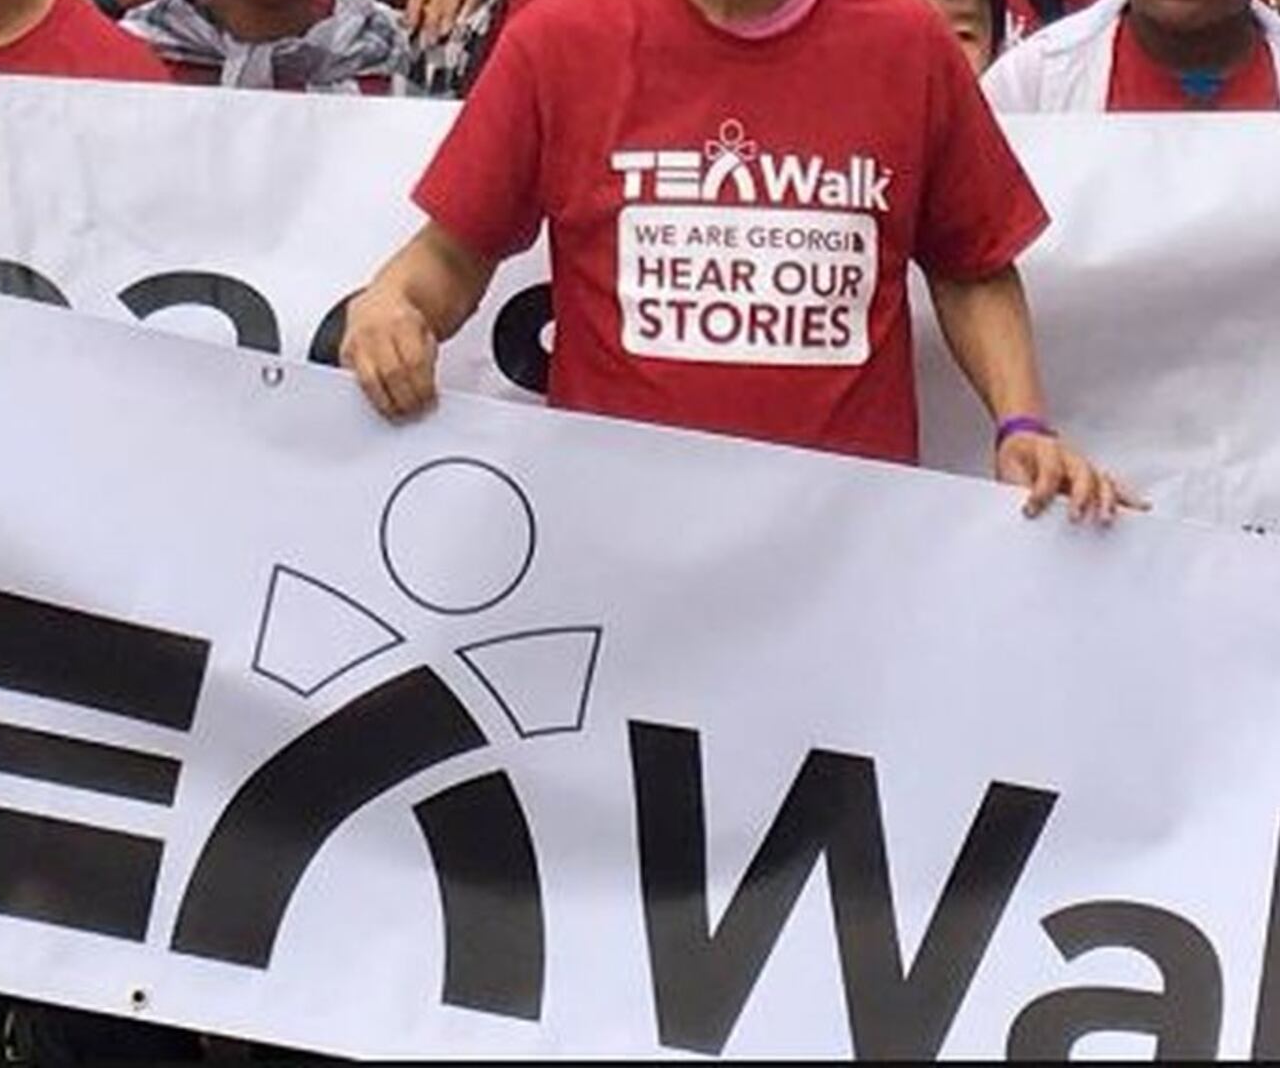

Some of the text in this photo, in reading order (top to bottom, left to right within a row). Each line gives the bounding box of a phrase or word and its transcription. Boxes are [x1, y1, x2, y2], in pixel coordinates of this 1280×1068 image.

[634, 224, 677, 247] WE
[686, 226, 740, 249] ARE
[636, 257, 864, 299] HEAR OUR
[637, 298, 851, 349] STORIES
